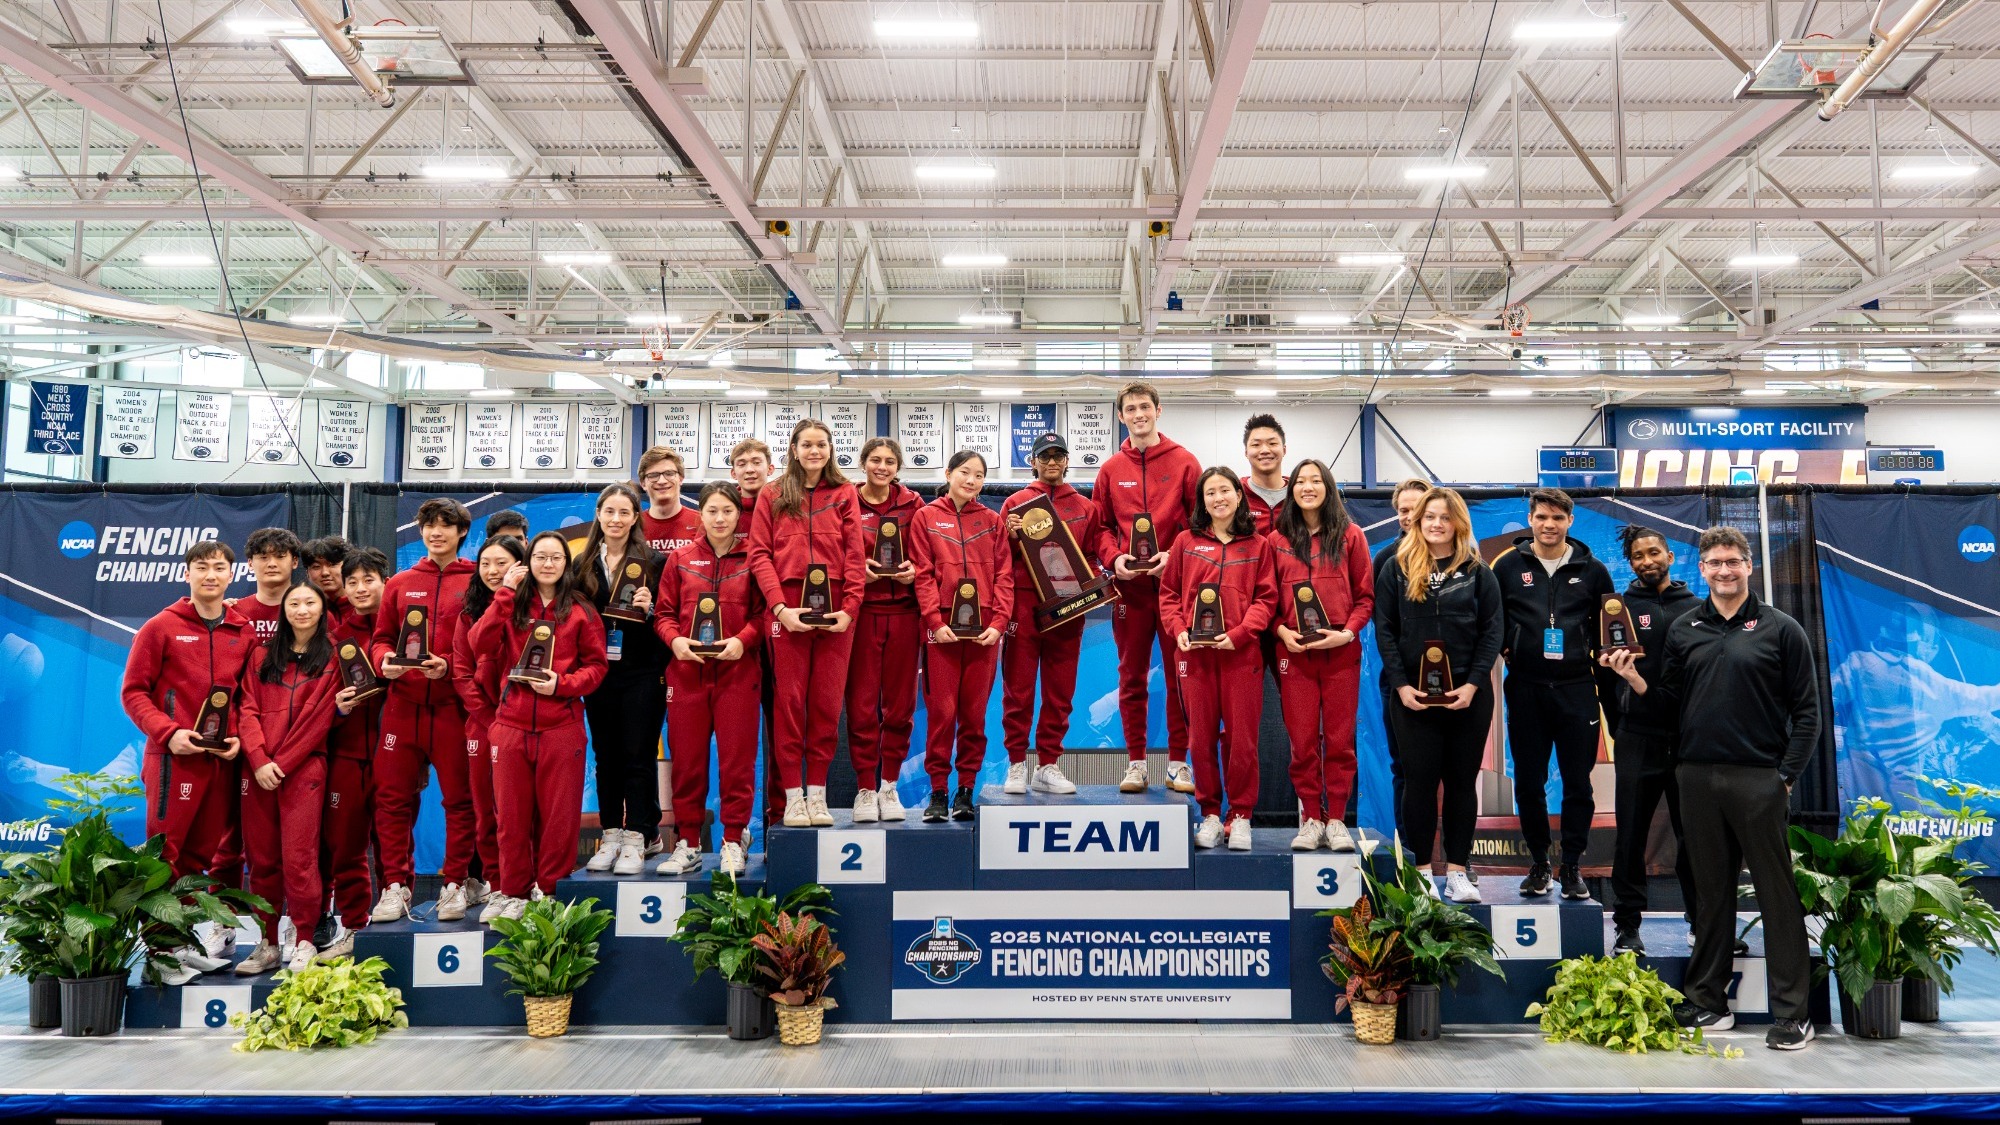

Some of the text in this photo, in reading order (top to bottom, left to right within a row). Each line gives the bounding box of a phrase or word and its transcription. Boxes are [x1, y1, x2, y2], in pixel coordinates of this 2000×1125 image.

[1662, 422, 1854, 436] MULTI-SPORT FACILITY
[1026, 518, 1052, 536] NCAA
[61, 539, 95, 550] NCAA
[1962, 542, 1996, 552] NCAA
[1071, 598, 1085, 610] PLACE
[1009, 821, 1160, 852] TEAM
[840, 844, 862, 870] 2
[1469, 840, 1517, 856] ATIONAL
[1316, 868, 1339, 895] 3
[640, 896, 662, 924] 3
[990, 931, 1271, 943] 2025 NATIONAL COLLEGIATE
[1516, 919, 1538, 946] 5
[438, 946, 459, 972] 6
[908, 952, 979, 961] CHAMPIONSHIPS
[992, 948, 1270, 976] FENCING CHAMPIONSHIPS
[204, 1000, 227, 1027] 8
